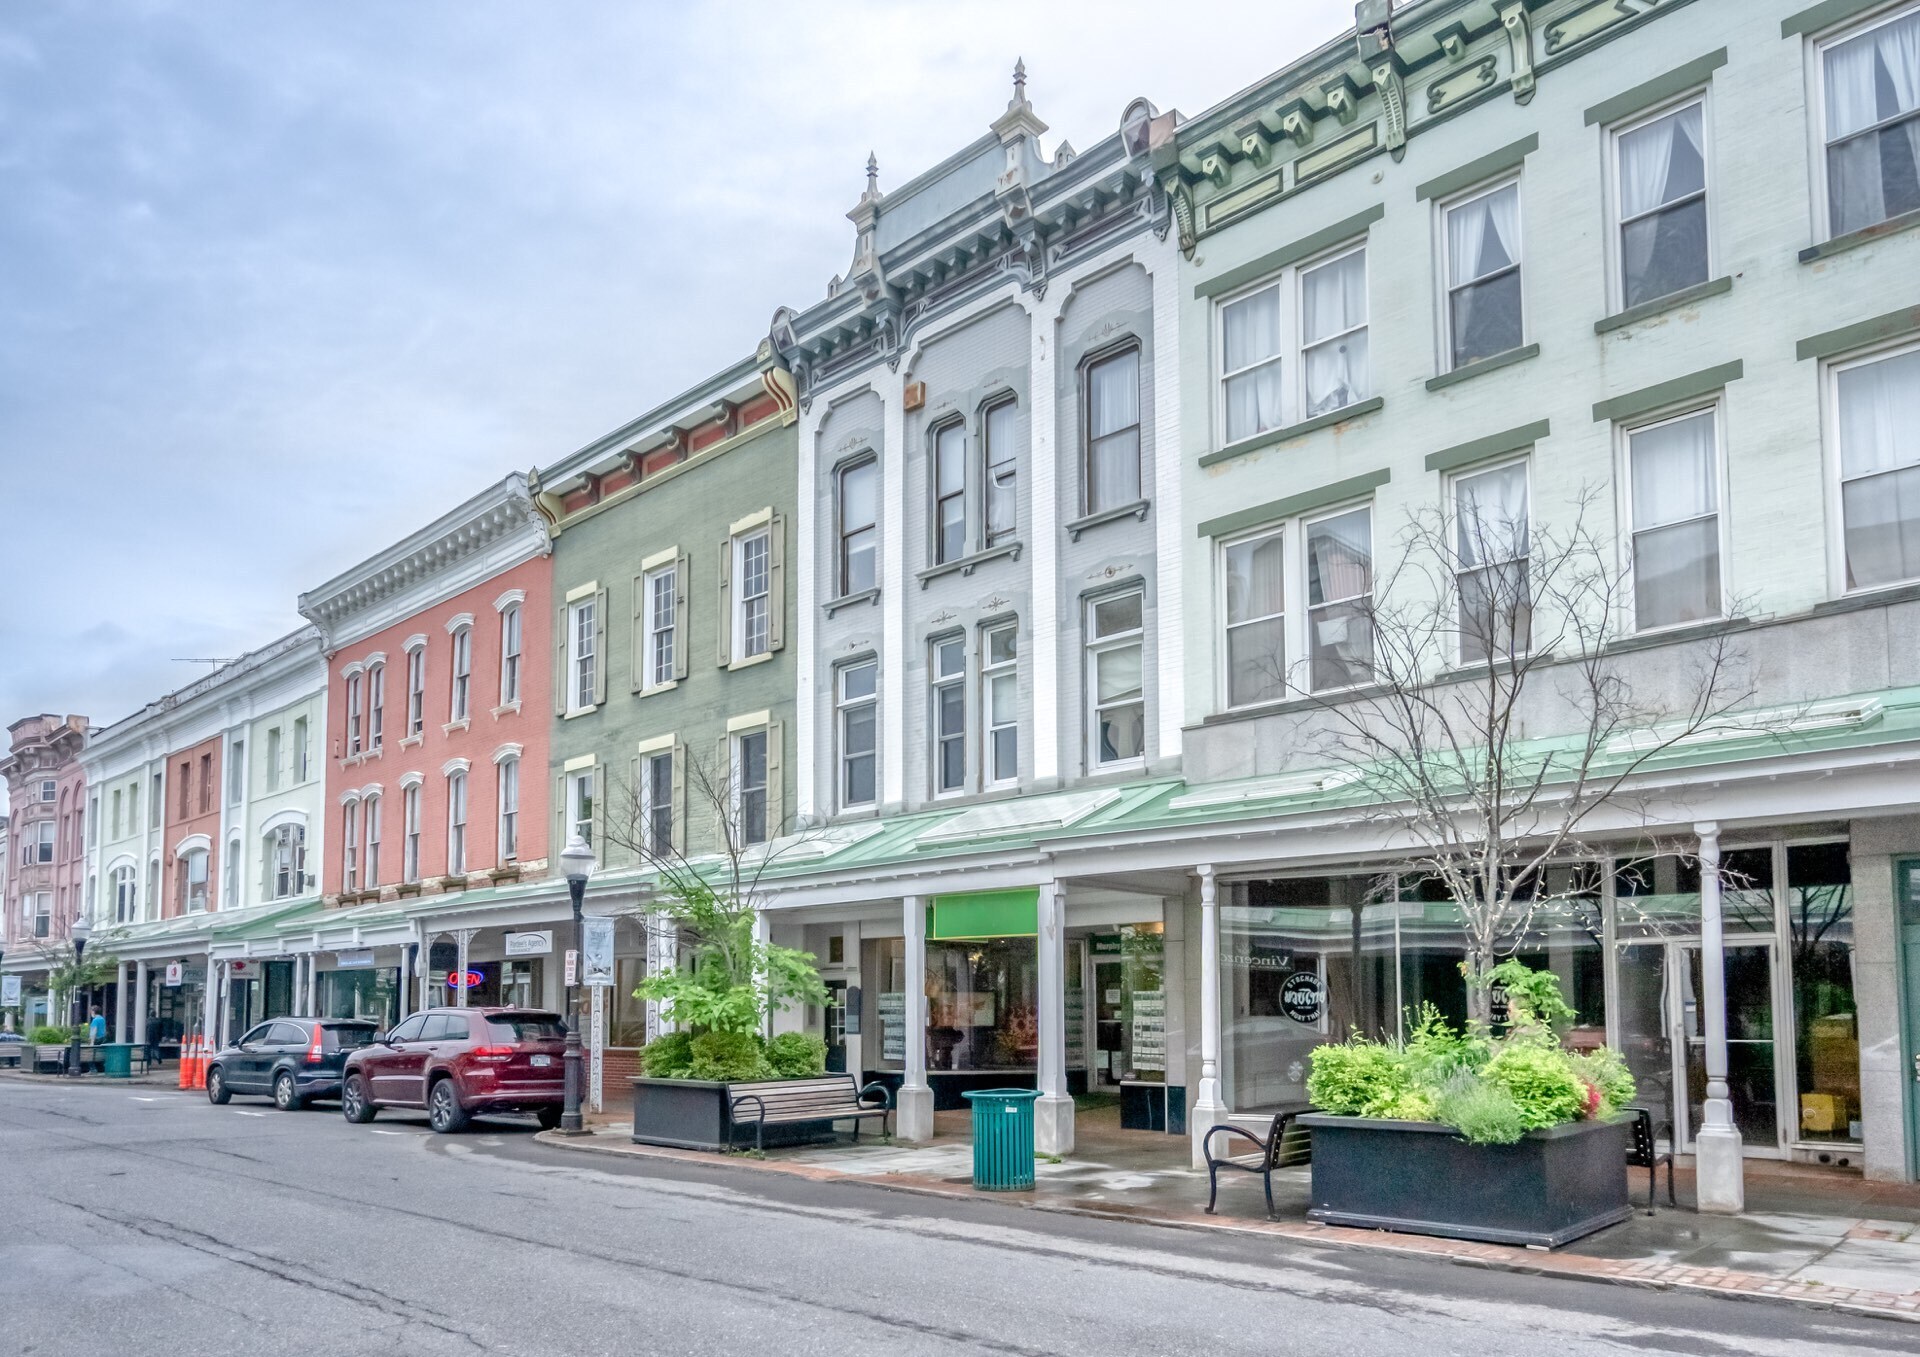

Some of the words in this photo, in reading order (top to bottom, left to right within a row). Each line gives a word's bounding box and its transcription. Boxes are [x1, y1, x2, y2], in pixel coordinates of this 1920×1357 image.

[528, 939, 544, 949] Agency
[449, 972, 481, 985] OEN
[1289, 1009, 1306, 1021] MUAY
[1305, 1009, 1321, 1021] THAI
